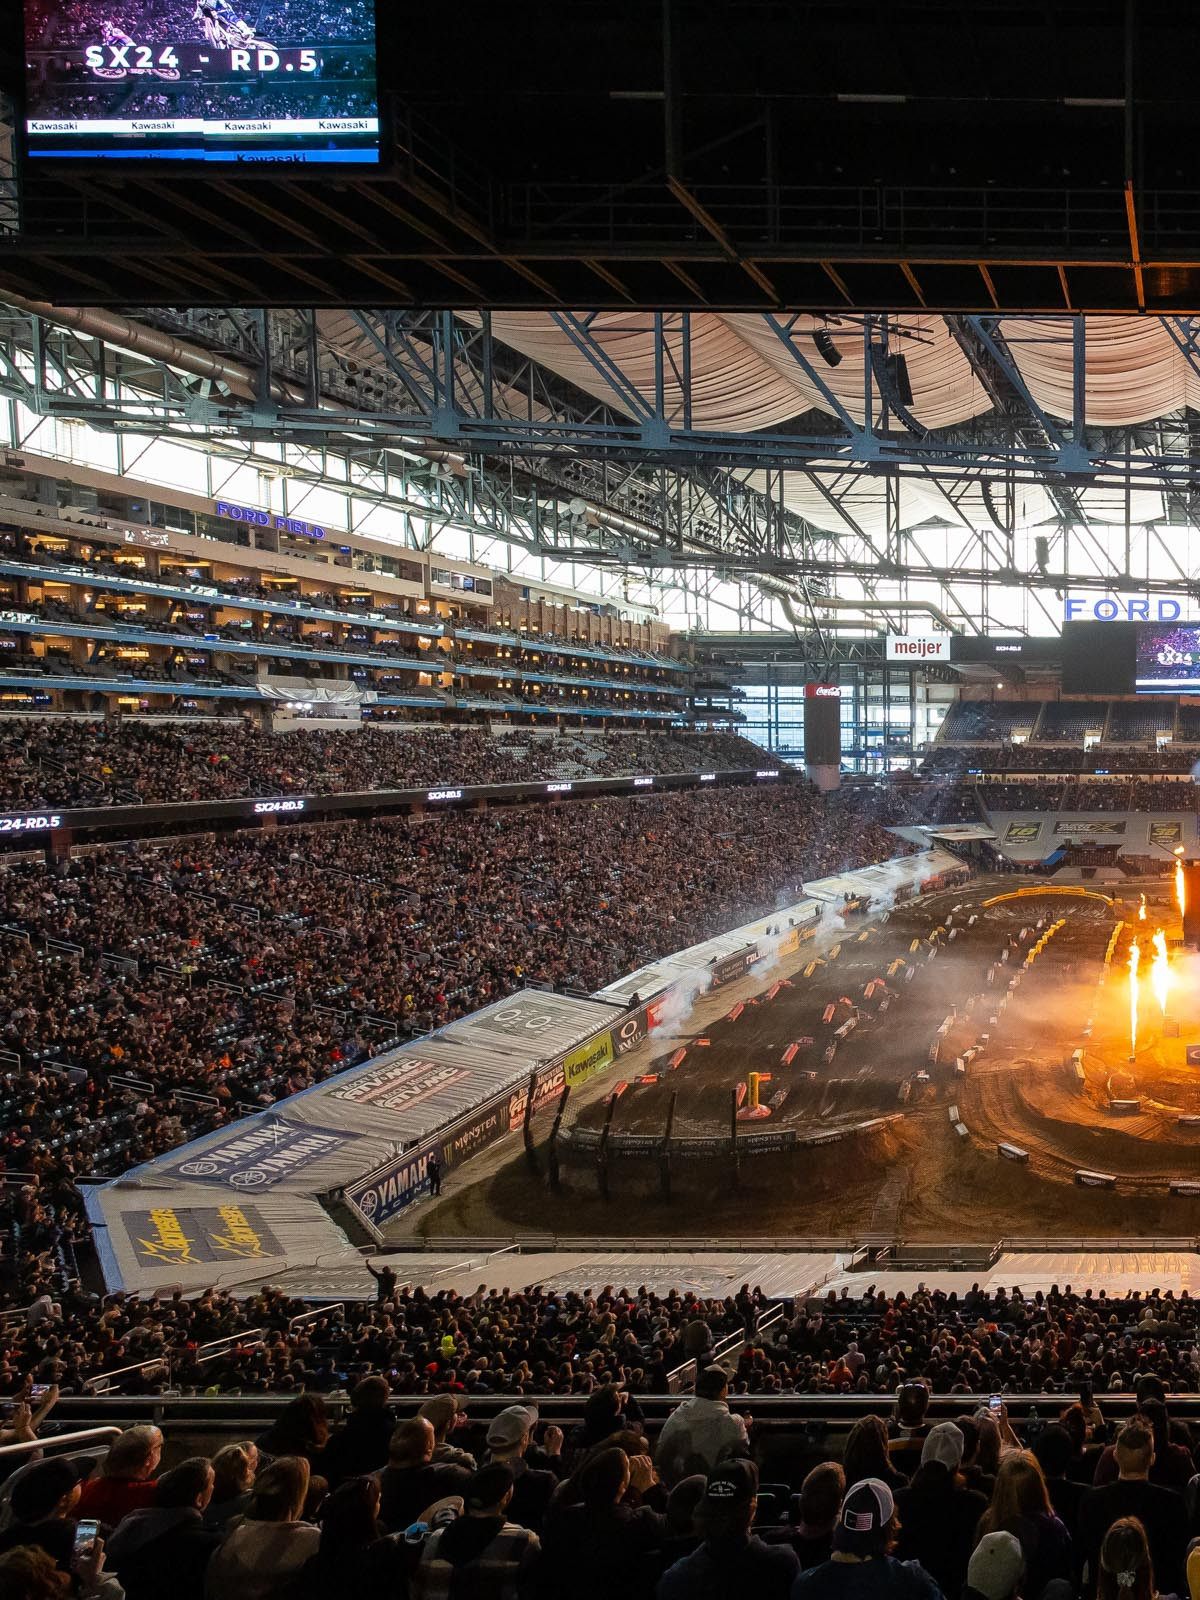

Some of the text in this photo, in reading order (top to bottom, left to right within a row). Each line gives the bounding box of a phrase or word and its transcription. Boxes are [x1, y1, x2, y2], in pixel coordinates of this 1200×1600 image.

[85, 46, 178, 68] SX24
[231, 50, 317, 71] RD.5
[31, 120, 368, 131] Kawasaki Kawasaki Kawasaki Kawasaki
[216, 500, 326, 540] FORD FIELD
[1065, 599, 1181, 622] FORD
[895, 638, 942, 657] meijer
[1157, 652, 1193, 662] SX24
[254, 800, 305, 813] SX24-RD.5
[568, 1043, 608, 1078] Kawasaki
[207, 1122, 295, 1164] YAMAHA
[455, 1114, 497, 1150] MONSTER
[249, 1133, 341, 1173] YAMAHA
